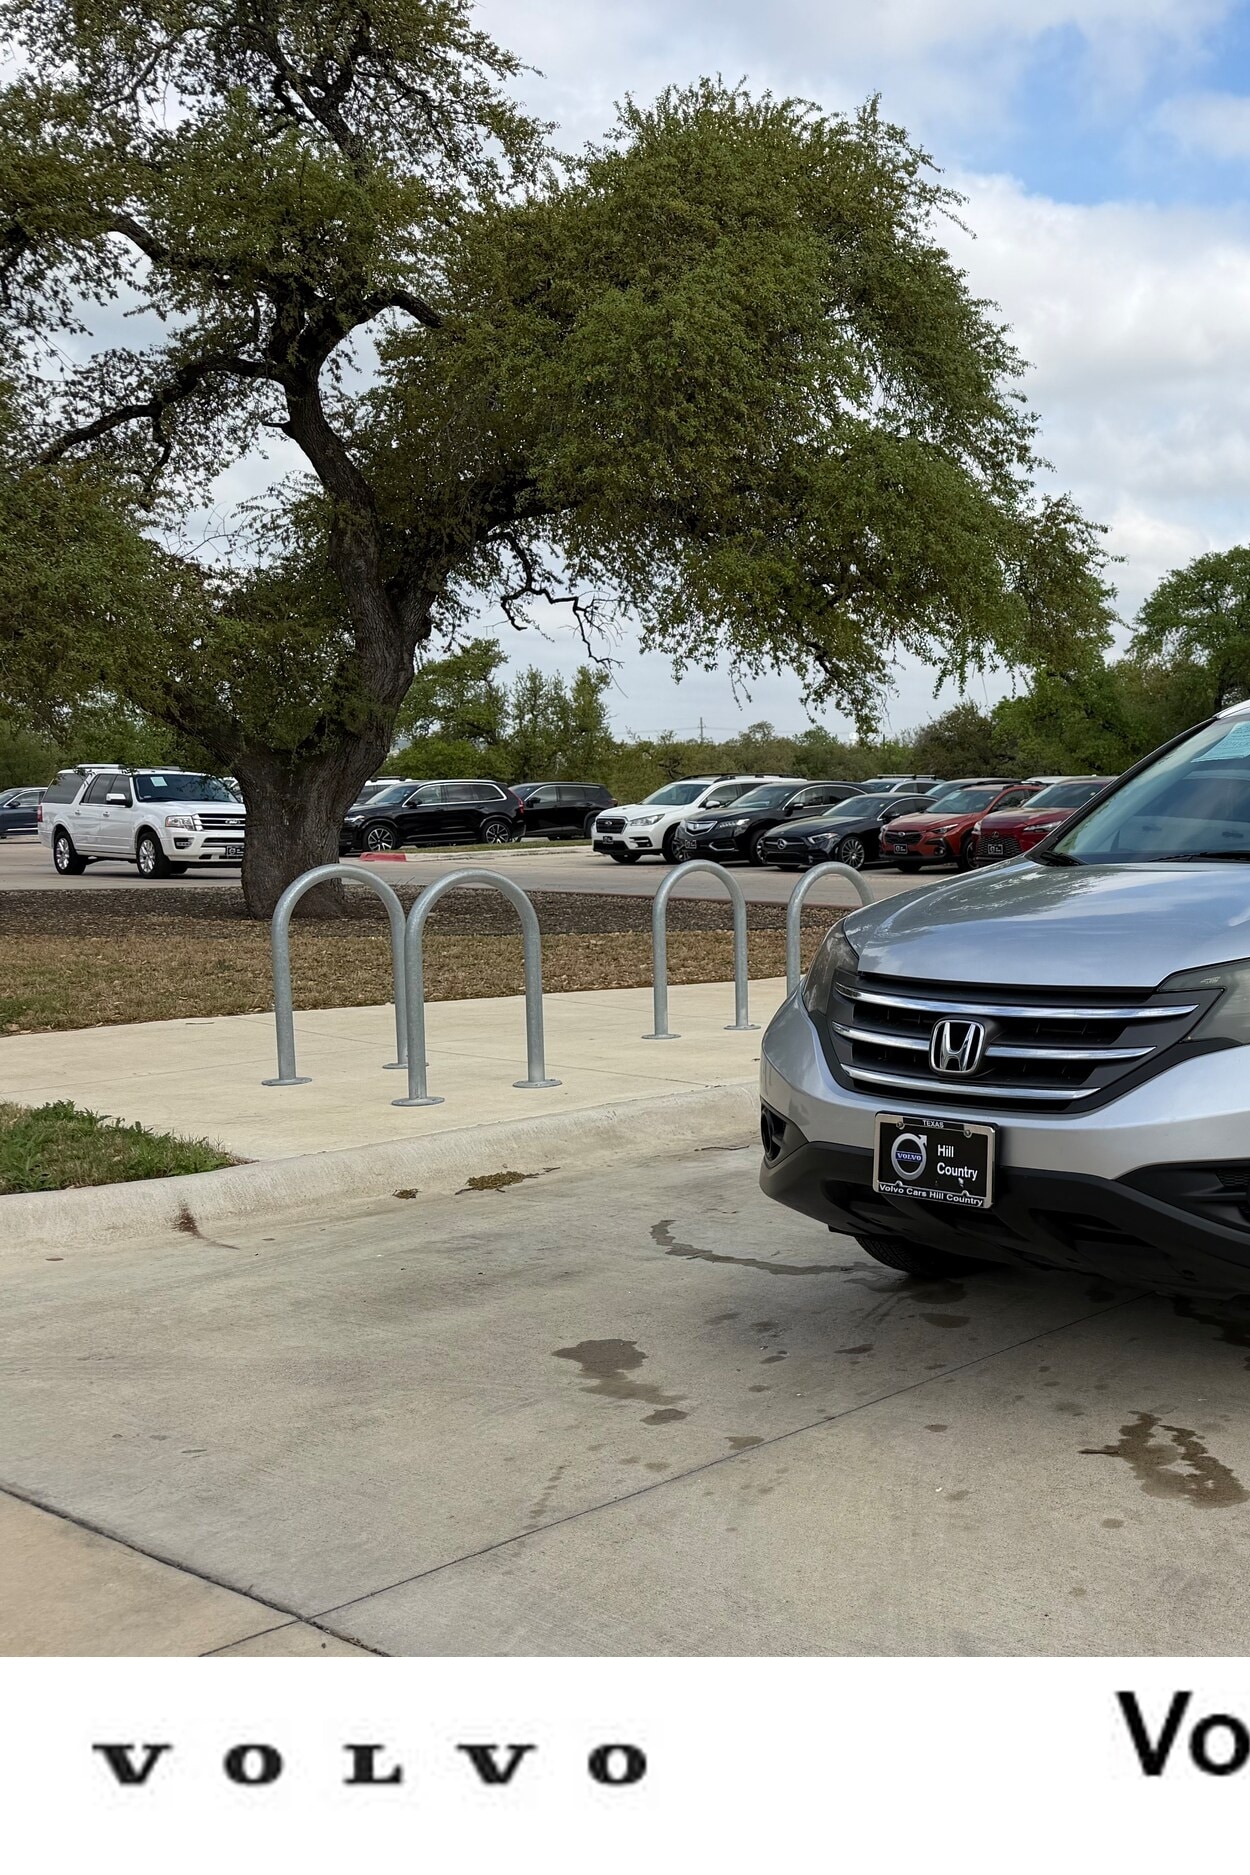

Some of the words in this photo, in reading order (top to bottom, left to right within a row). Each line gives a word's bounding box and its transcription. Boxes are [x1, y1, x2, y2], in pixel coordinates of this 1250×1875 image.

[923, 1120, 944, 1129] TEXAS
[896, 1152, 922, 1161] VOLVO
[937, 1144, 954, 1158] Hill
[937, 1162, 978, 1181] Country
[879, 1184, 904, 1194] Volvo
[906, 1188, 927, 1197] Cars
[929, 1191, 944, 1200] Hill
[946, 1193, 983, 1206] Country
